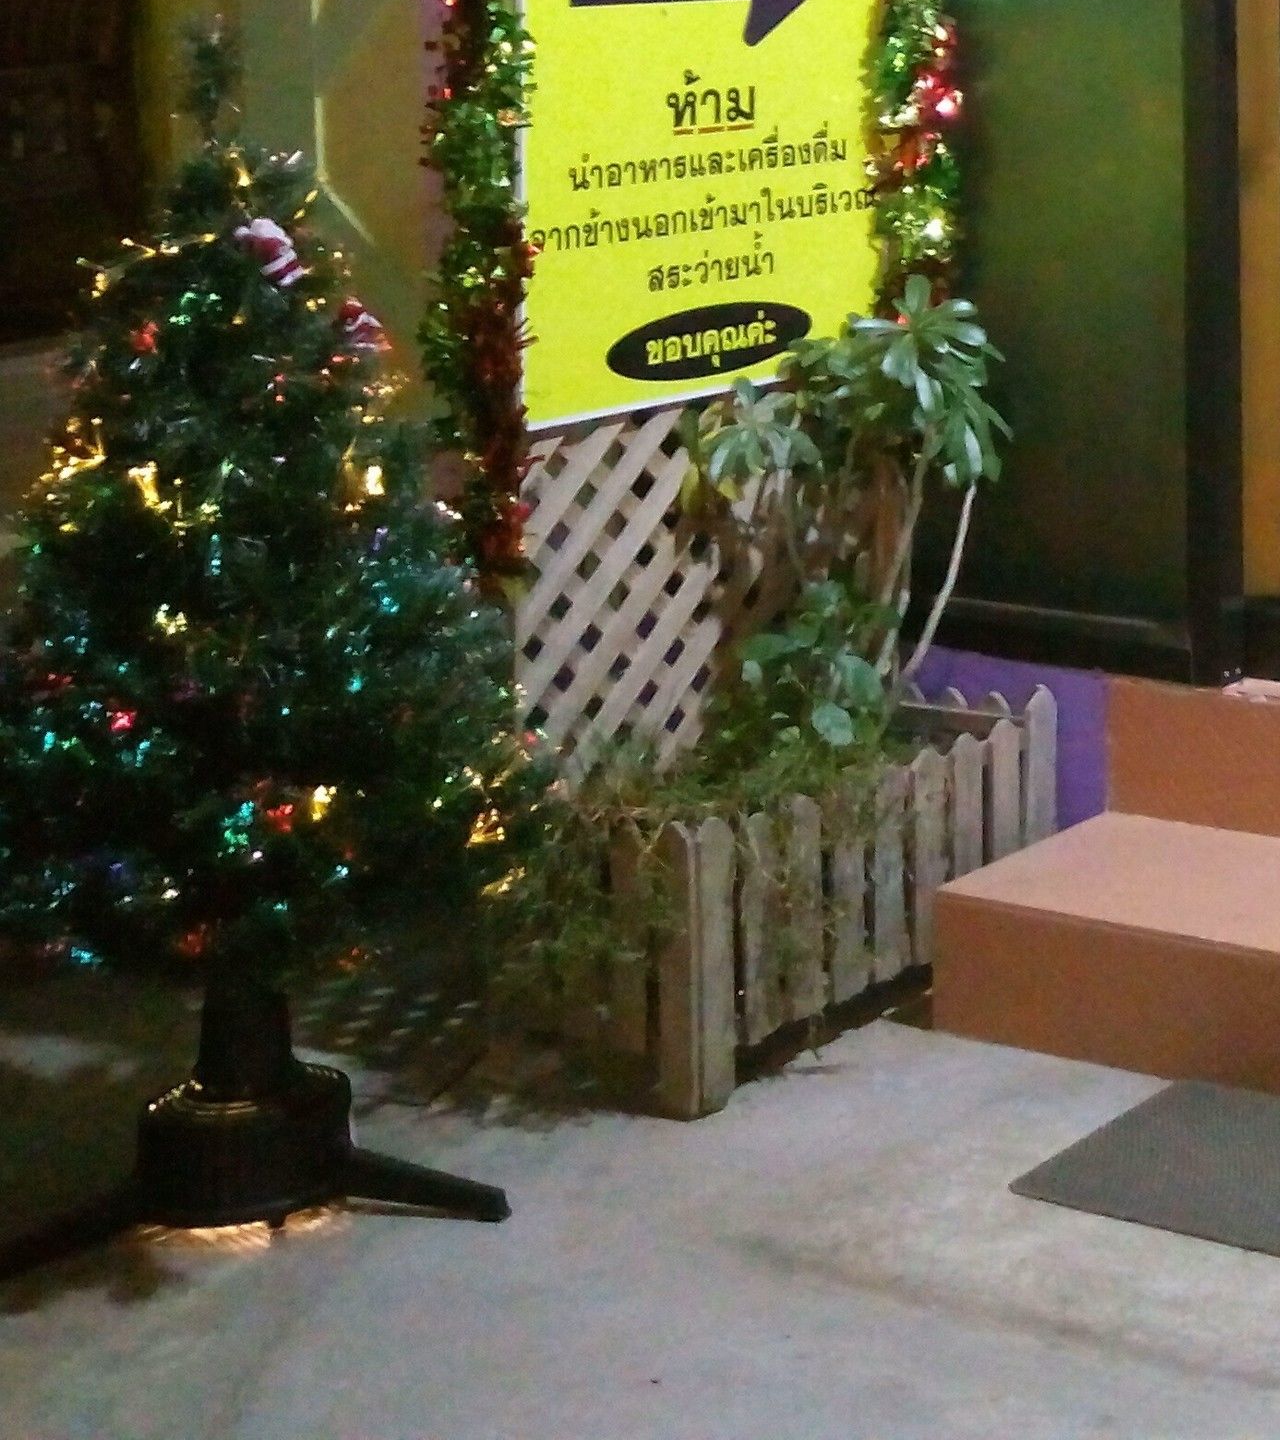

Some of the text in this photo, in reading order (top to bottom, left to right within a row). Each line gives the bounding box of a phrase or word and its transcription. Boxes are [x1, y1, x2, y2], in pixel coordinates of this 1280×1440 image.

[665, 70, 756, 128] ห้าม
[568, 121, 848, 191] นำอาหารและเครื่องดื่ม
[647, 230, 775, 292] สระว่ายน้ำ
[645, 310, 778, 368] ขอบคุณค่ะ
